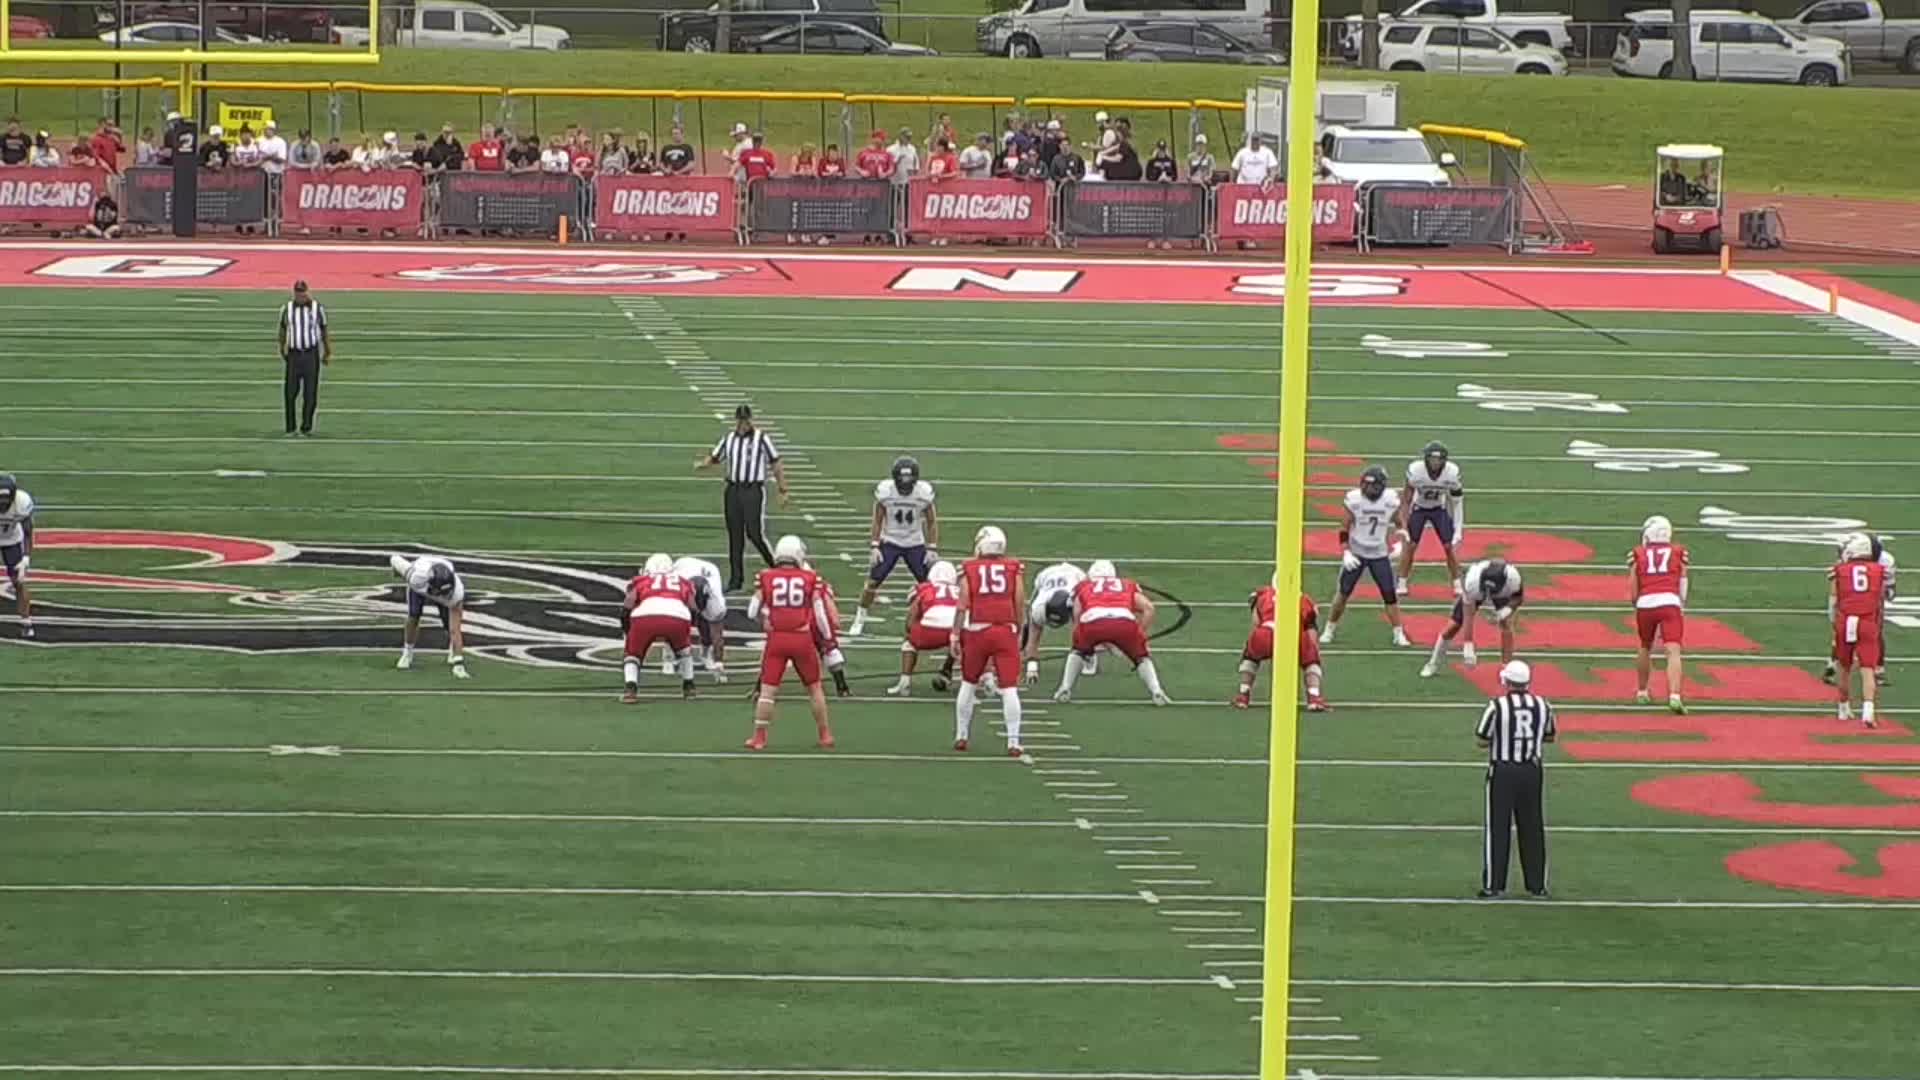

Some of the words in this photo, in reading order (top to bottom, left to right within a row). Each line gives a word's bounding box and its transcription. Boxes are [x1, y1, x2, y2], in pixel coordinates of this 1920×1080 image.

[895, 508, 914, 525] 44
[1367, 516, 1379, 537] 7
[1646, 547, 1673, 574] 17
[771, 576, 805, 608] 26
[978, 563, 1008, 594] 15
[1091, 577, 1123, 594] 73
[1851, 564, 1869, 593] 6
[1513, 708, 1535, 739] R
